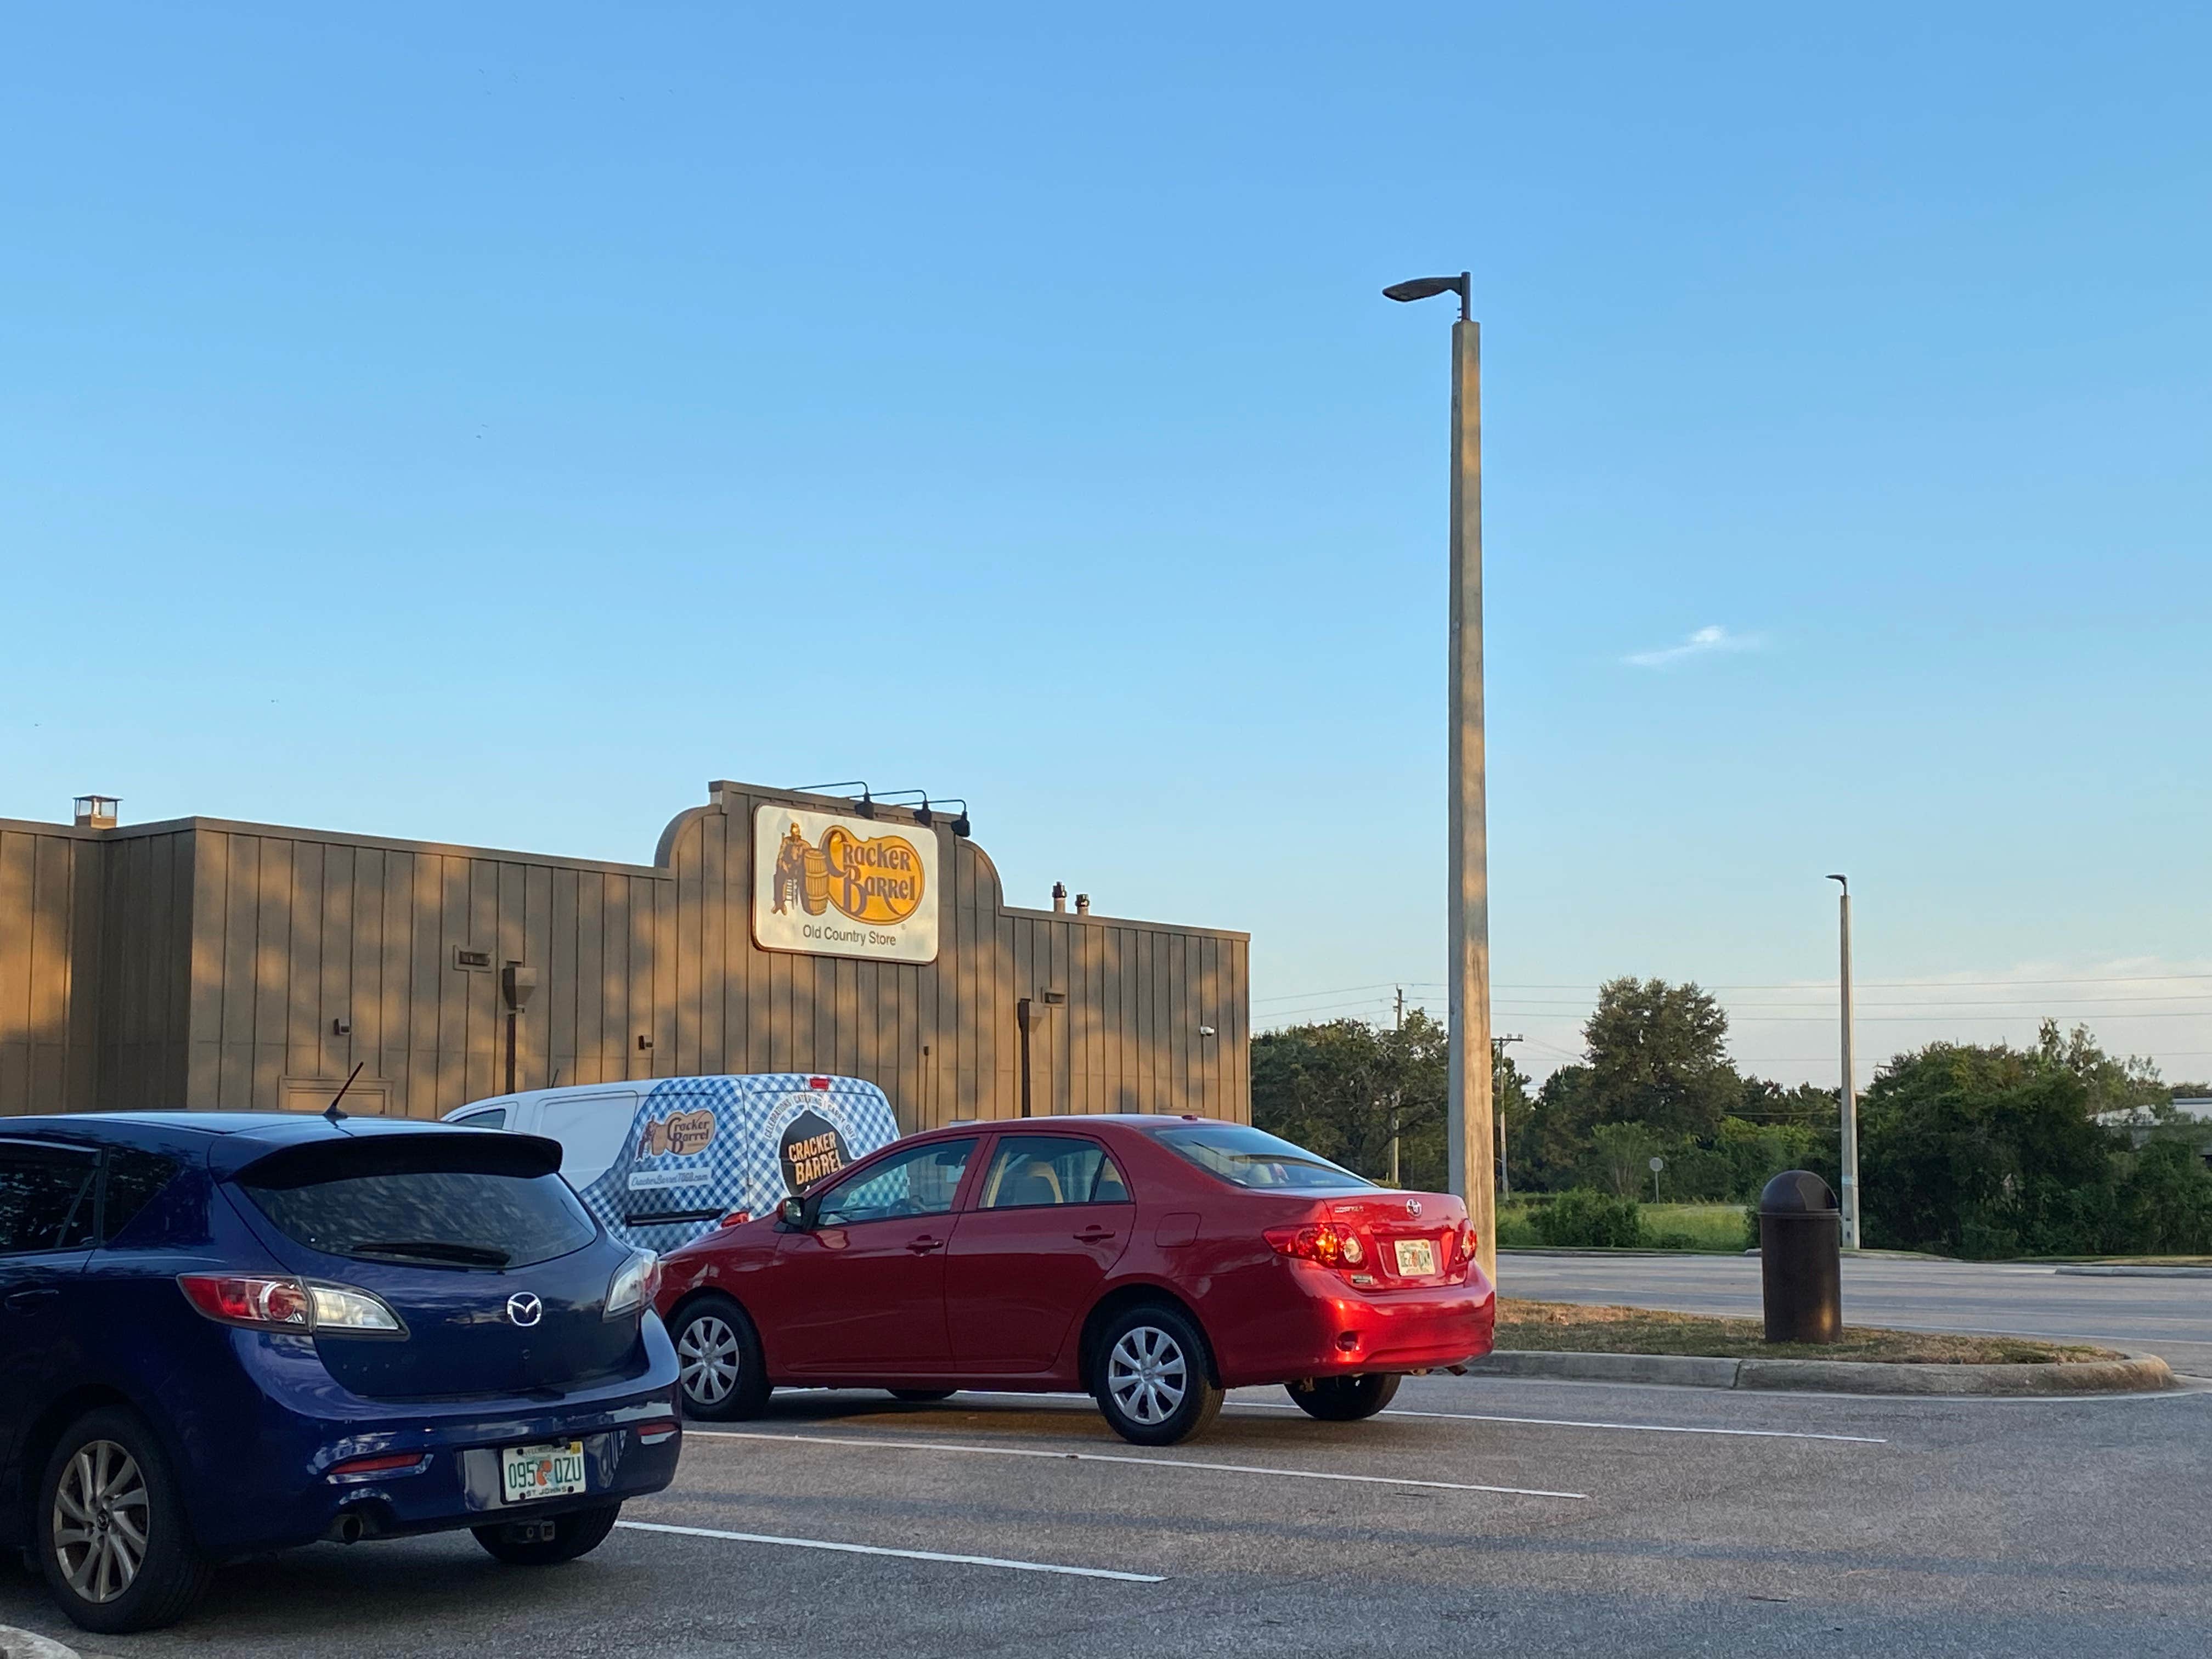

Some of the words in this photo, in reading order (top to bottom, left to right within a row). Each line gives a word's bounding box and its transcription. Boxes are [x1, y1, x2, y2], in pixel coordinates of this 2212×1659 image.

[803, 924, 821, 939] Old
[825, 927, 866, 946] Country
[869, 931, 896, 946] Store
[667, 1117, 709, 1142] Cracker
[764, 1098, 792, 1138] CELEBRATIONS
[828, 1104, 845, 1123] CARRY
[845, 1125, 856, 1138] OUT
[788, 1131, 837, 1163] CRACKER
[795, 1149, 845, 1185] BARREL
[508, 1460, 535, 1488] 095
